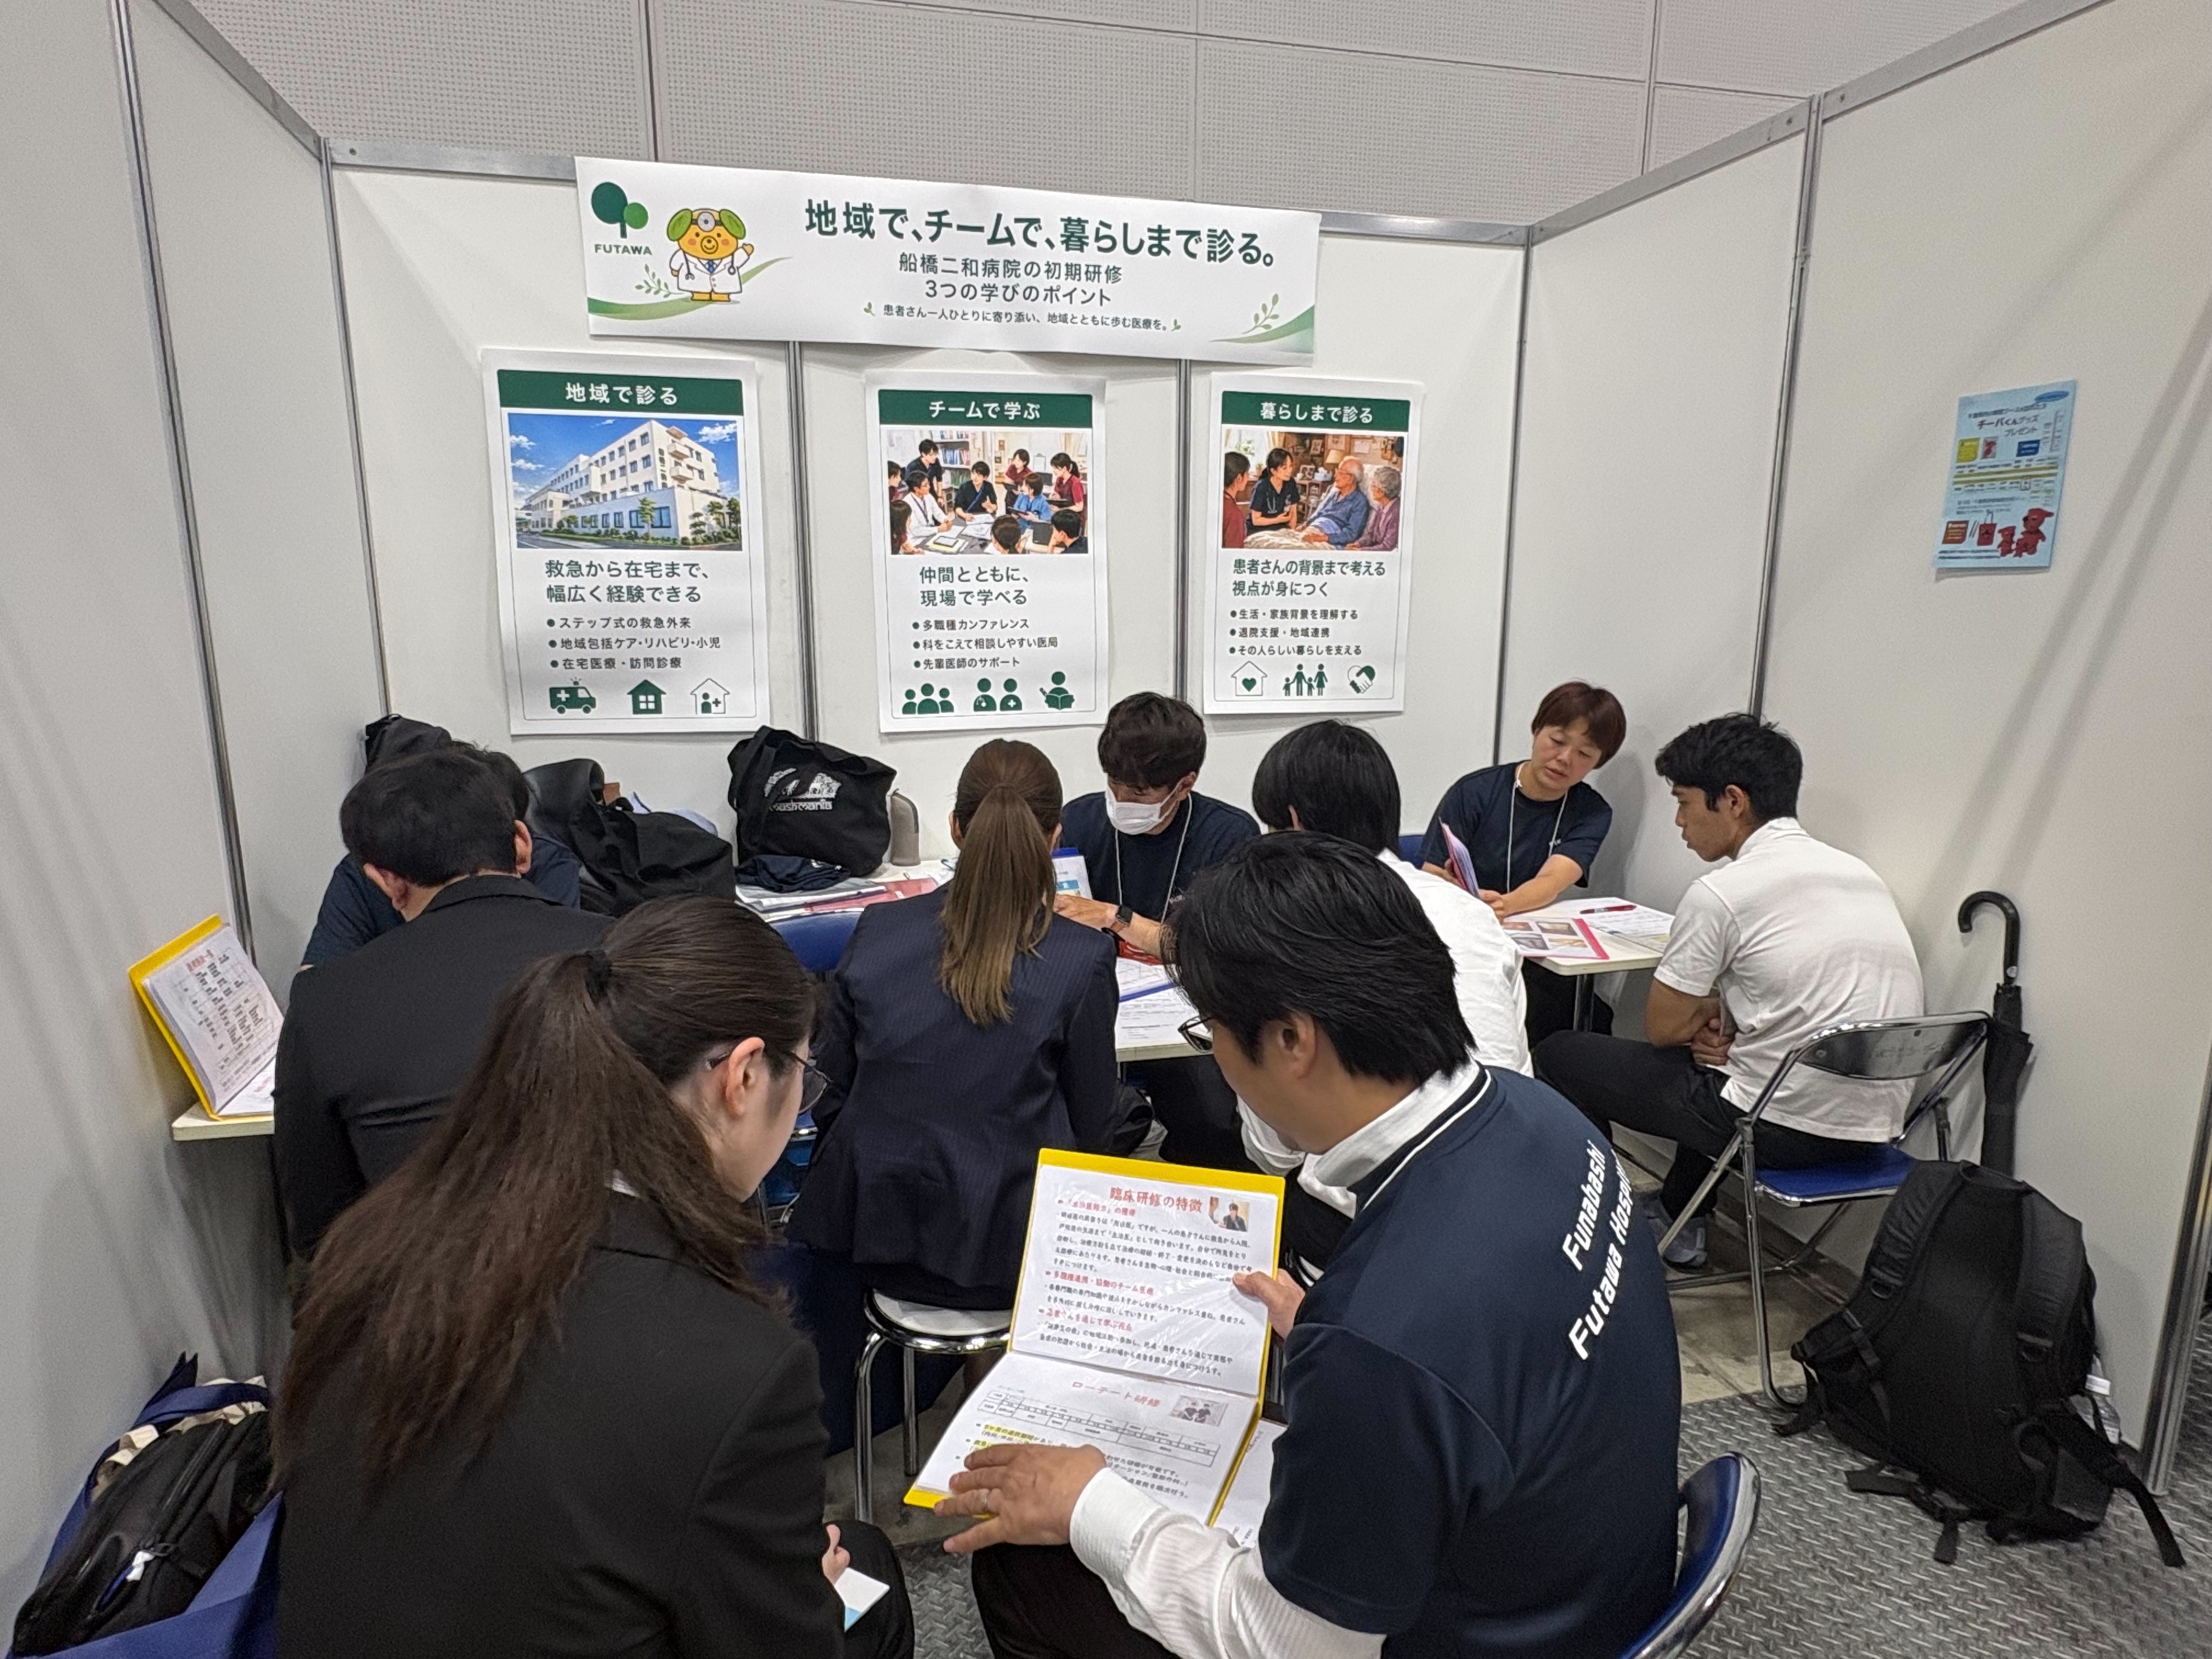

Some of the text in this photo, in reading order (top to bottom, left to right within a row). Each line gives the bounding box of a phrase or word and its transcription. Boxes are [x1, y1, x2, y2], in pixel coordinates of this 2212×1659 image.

[805, 199, 1273, 267] 地域で、チームで、暮らしまで診る。
[595, 244, 652, 256] FUTAWA
[899, 252, 1122, 284] 船橋二和病院の初期研修
[925, 280, 1111, 307] 3つの学びのポイント
[883, 304, 1167, 331] 患者さん一人ひとりに寄り添い、地域とともに歩む医療を。
[566, 382, 678, 406] 地域で診る
[929, 400, 1041, 420] チームで学ぶ
[1260, 402, 1373, 424] 暮らしまで診る
[545, 560, 709, 579] 救急から在宅まで、
[919, 566, 1030, 584] 仲間とともに、
[1233, 558, 1385, 577] 患者さんの背景まで考える
[546, 585, 702, 603] 幅広く経験できる
[1232, 580, 1329, 597] 視点が身につく
[920, 589, 1028, 607] 現場で学べる
[560, 617, 692, 629] ステップ式の救急外来
[923, 619, 1030, 631] 多職種カンファレンス
[561, 636, 721, 650] 地域包括ケア・リハビリ・小児
[923, 636, 1058, 651] 科をこえて相談しやすい医局
[1238, 645, 1362, 656] その人らしい暮らしを支える
[562, 657, 682, 669] 在宅医療・訪問診療
[923, 656, 1020, 670] 先輩医師のサポート
[1562, 1139, 1606, 1272] Funabashi
[1568, 1242, 1623, 1361] Futawa
